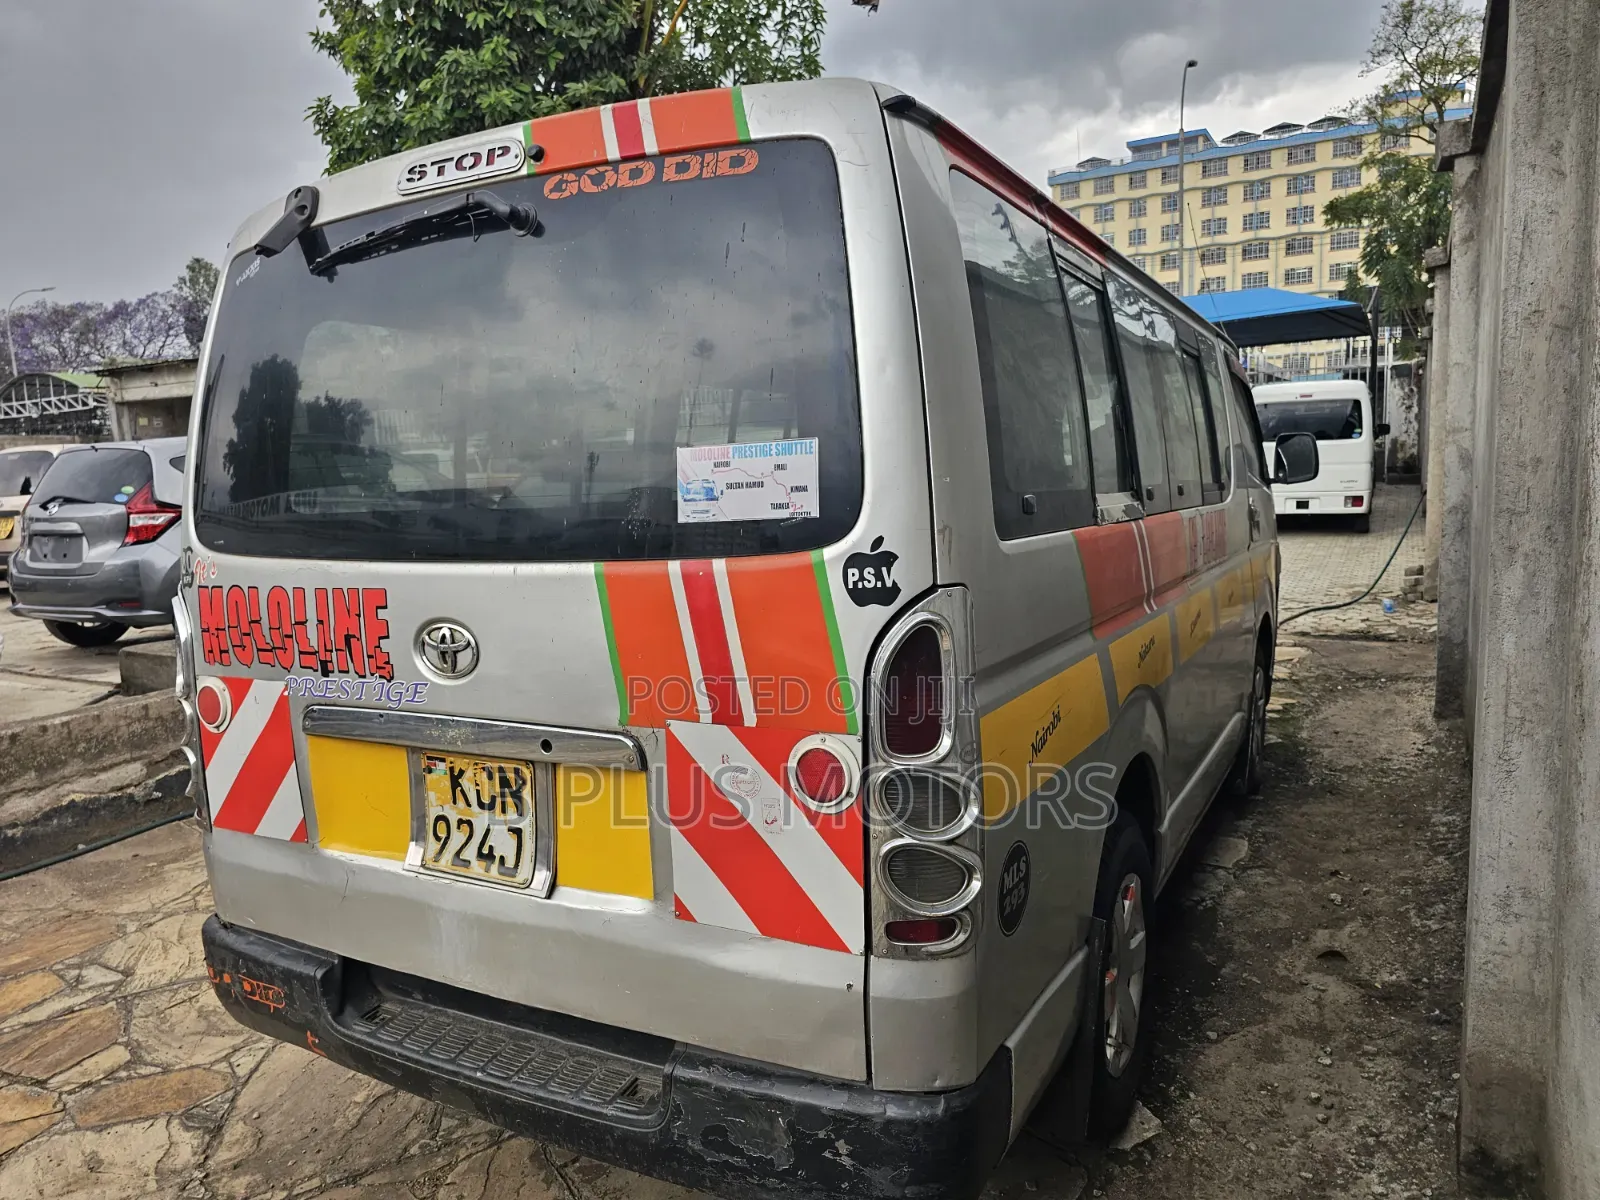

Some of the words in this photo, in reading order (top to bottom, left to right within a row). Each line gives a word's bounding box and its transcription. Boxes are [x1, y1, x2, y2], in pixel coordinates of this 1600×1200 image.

[406, 145, 511, 183] STOP
[543, 160, 656, 199] GOD
[662, 148, 759, 182] DID
[731, 443, 774, 459] PRESTIGE
[774, 440, 814, 457] SHUTTLE
[725, 482, 745, 490] SULTAN
[745, 481, 765, 489] HAMUD
[198, 585, 394, 682] MOLOLINE
[284, 674, 429, 710] PRESTIGE
[1028, 704, 1062, 767] Nairobi
[432, 814, 523, 878] 924J
[1003, 855, 1027, 894] MLS
[1003, 881, 1025, 917] 293
